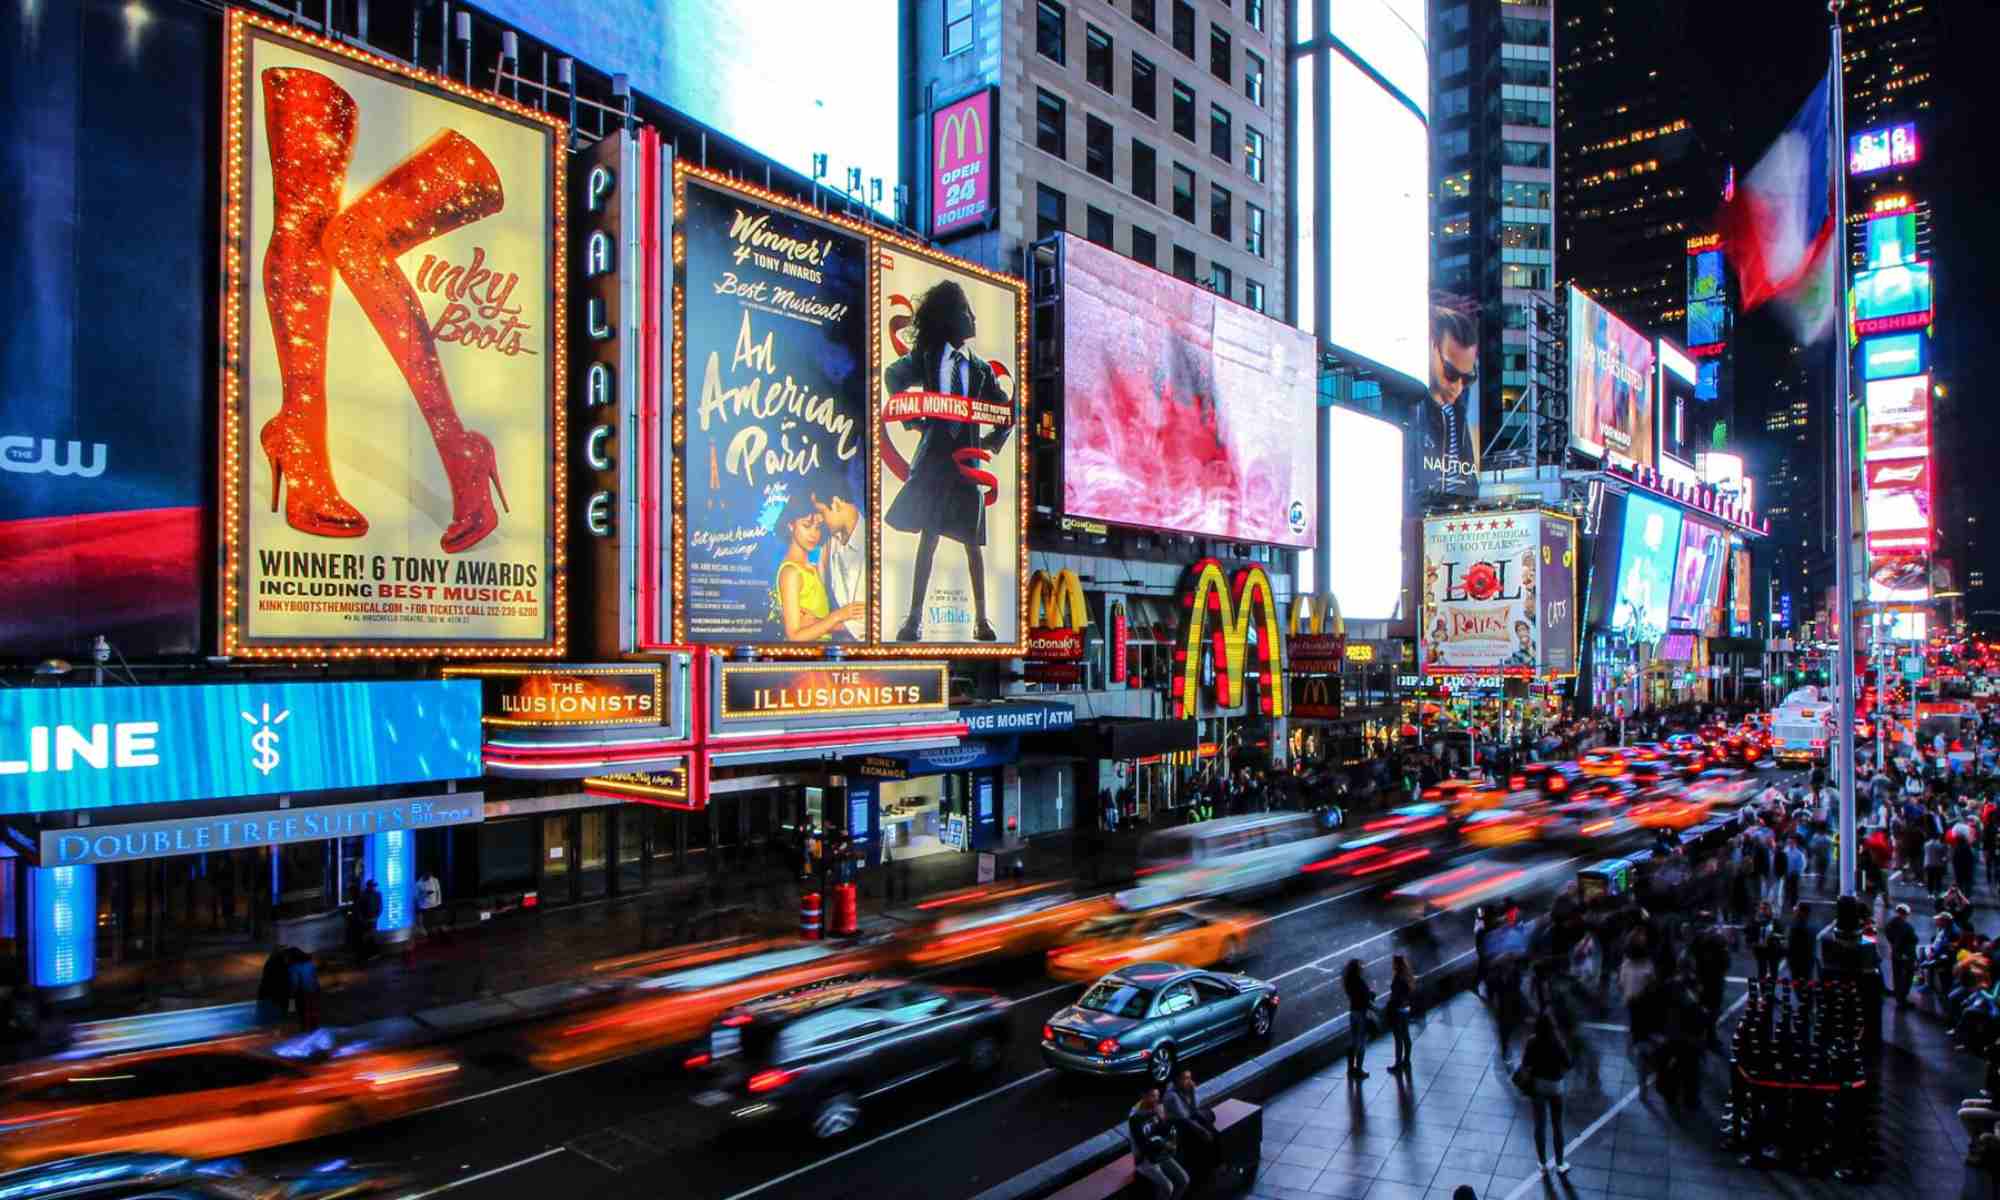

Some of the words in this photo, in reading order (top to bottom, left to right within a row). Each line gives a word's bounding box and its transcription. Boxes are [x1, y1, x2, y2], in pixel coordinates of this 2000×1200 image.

[941, 160, 981, 185] OPEN
[945, 179, 976, 208] 24
[936, 200, 985, 226] HOURS
[729, 209, 832, 267] Winner!
[733, 245, 751, 265] 4
[753, 252, 780, 272] TONY
[782, 260, 822, 284] AWARDS
[713, 272, 768, 301] Best
[770, 286, 848, 322] Musical!
[431, 302, 538, 355] Boots
[1857, 313, 1929, 334] TOSHIBA
[588, 167, 610, 535] PALACE
[731, 309, 776, 374] An
[697, 351, 857, 460] American
[888, 396, 921, 416] FINAL
[922, 395, 969, 417] MONTHS
[972, 411, 1006, 424] JANUARY
[725, 425, 820, 487] Paris
[1423, 454, 1480, 476] NAUTICA
[691, 529, 708, 546] Set
[259, 549, 364, 581] WINNER!
[372, 556, 385, 582] 6
[392, 557, 449, 583] TONY
[456, 561, 537, 587] AWARDS
[1441, 558, 1522, 602] LOL
[259, 580, 372, 597] INCLUDING
[378, 584, 438, 600] BEST
[443, 586, 537, 603] MUSICAL
[258, 600, 403, 614] KINKYBOOTSTHEMUSICAL.COM
[410, 603, 427, 615] FOR
[430, 604, 463, 616] TICKETS
[465, 605, 484, 616] CALL
[1548, 599, 1567, 628] CATS
[551, 683, 585, 695] THE
[833, 672, 861, 684] THE
[502, 694, 653, 714] ILLUSIONISTS
[754, 686, 921, 710] ILLUSIONISTS
[997, 712, 1042, 728] MONEY
[1049, 710, 1073, 724] ATM
[861, 766, 907, 777] EXCHANGE
[410, 800, 433, 813] BY
